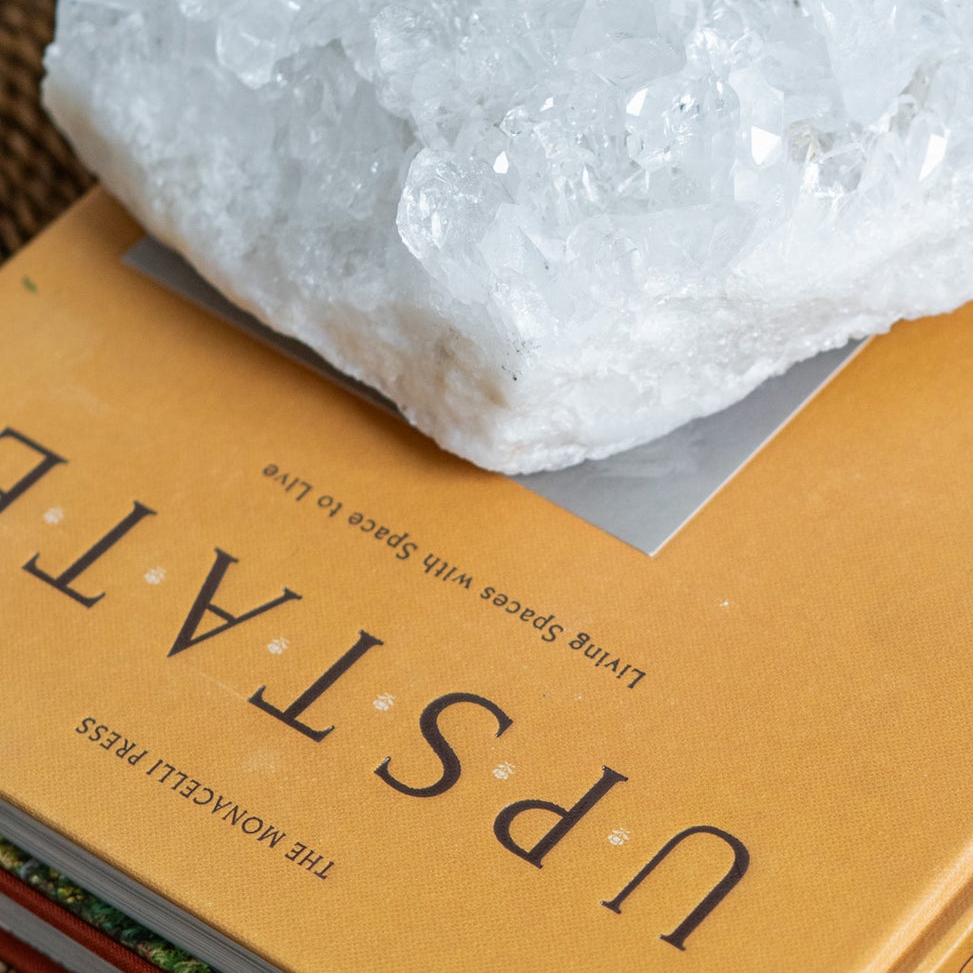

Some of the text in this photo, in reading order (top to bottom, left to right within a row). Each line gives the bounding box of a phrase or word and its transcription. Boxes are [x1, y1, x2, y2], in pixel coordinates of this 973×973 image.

[262, 463, 647, 689] Living Spaces with Space to Live
[74, 717, 335, 880] THE MONACELLI PRESS
